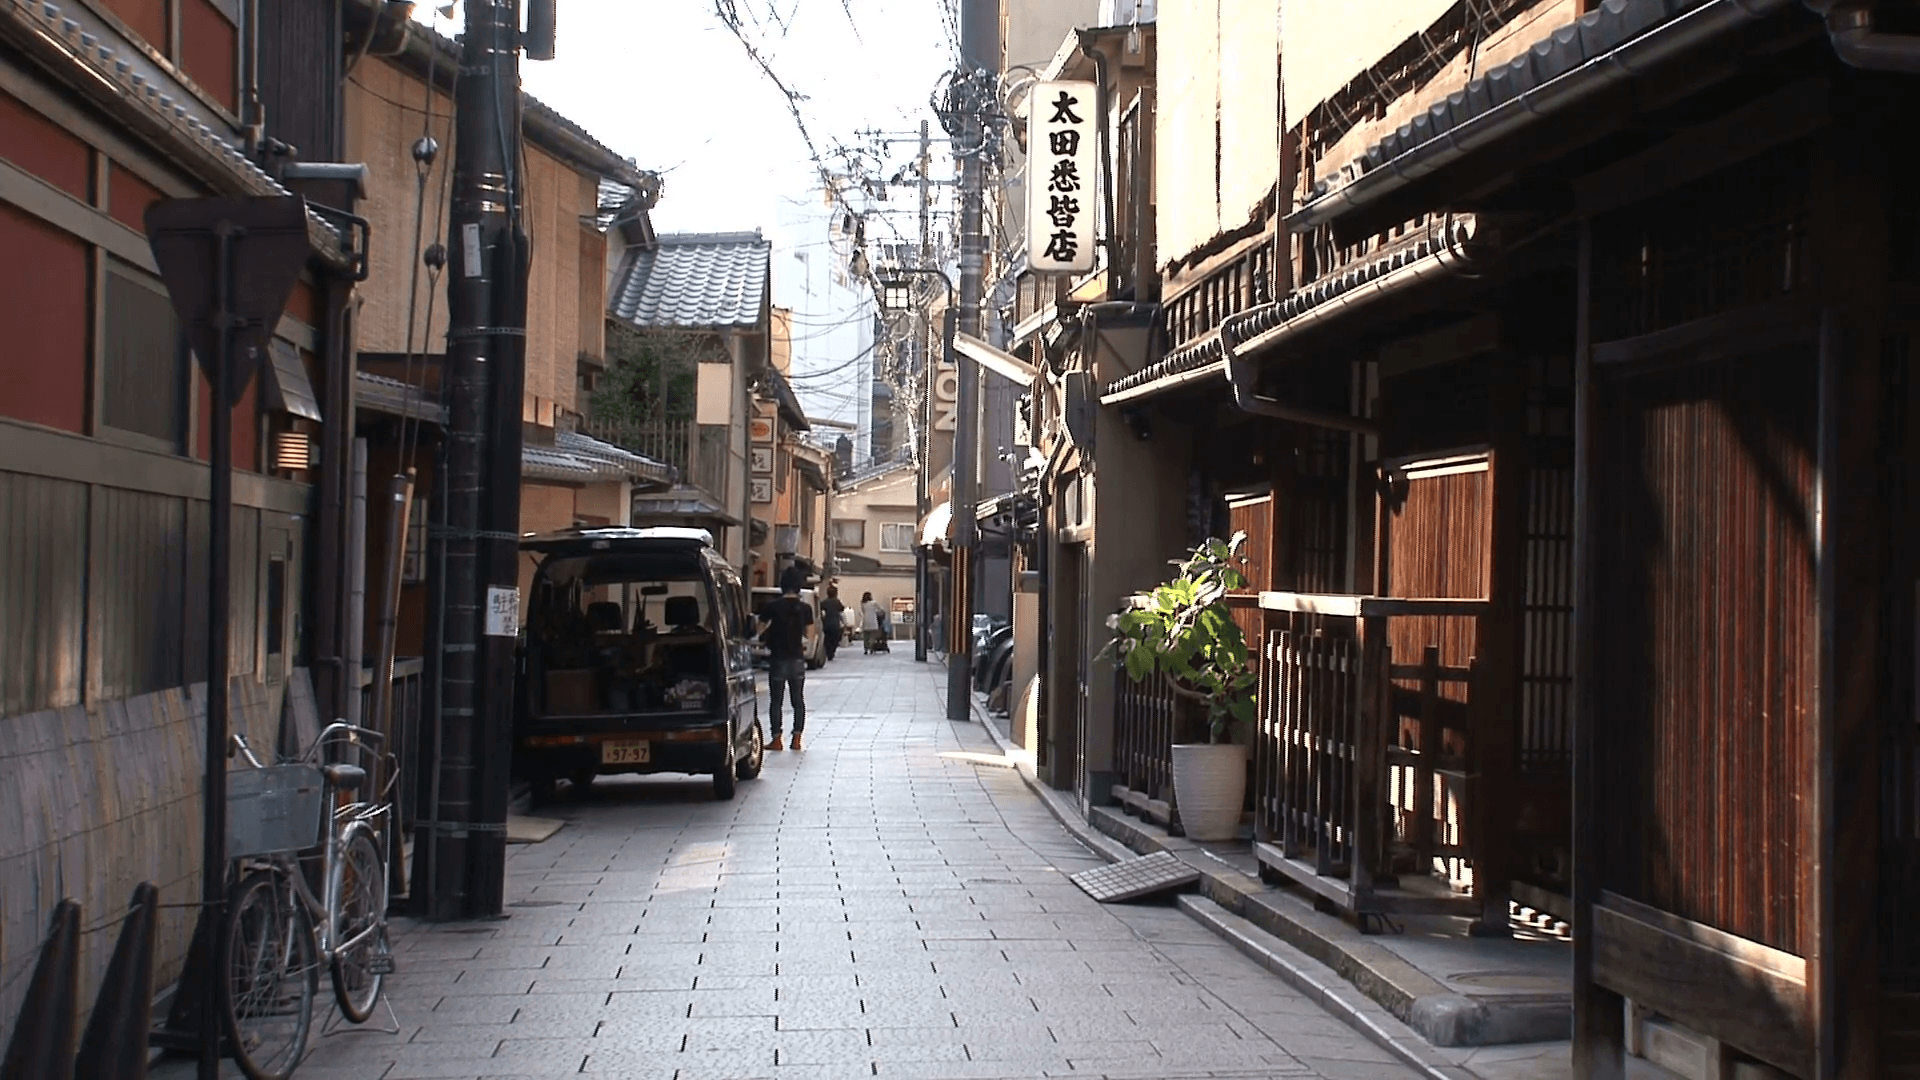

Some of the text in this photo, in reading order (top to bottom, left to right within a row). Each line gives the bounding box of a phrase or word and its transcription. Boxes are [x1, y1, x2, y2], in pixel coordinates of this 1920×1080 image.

[1044, 91, 1084, 262] 太田悉皆店
